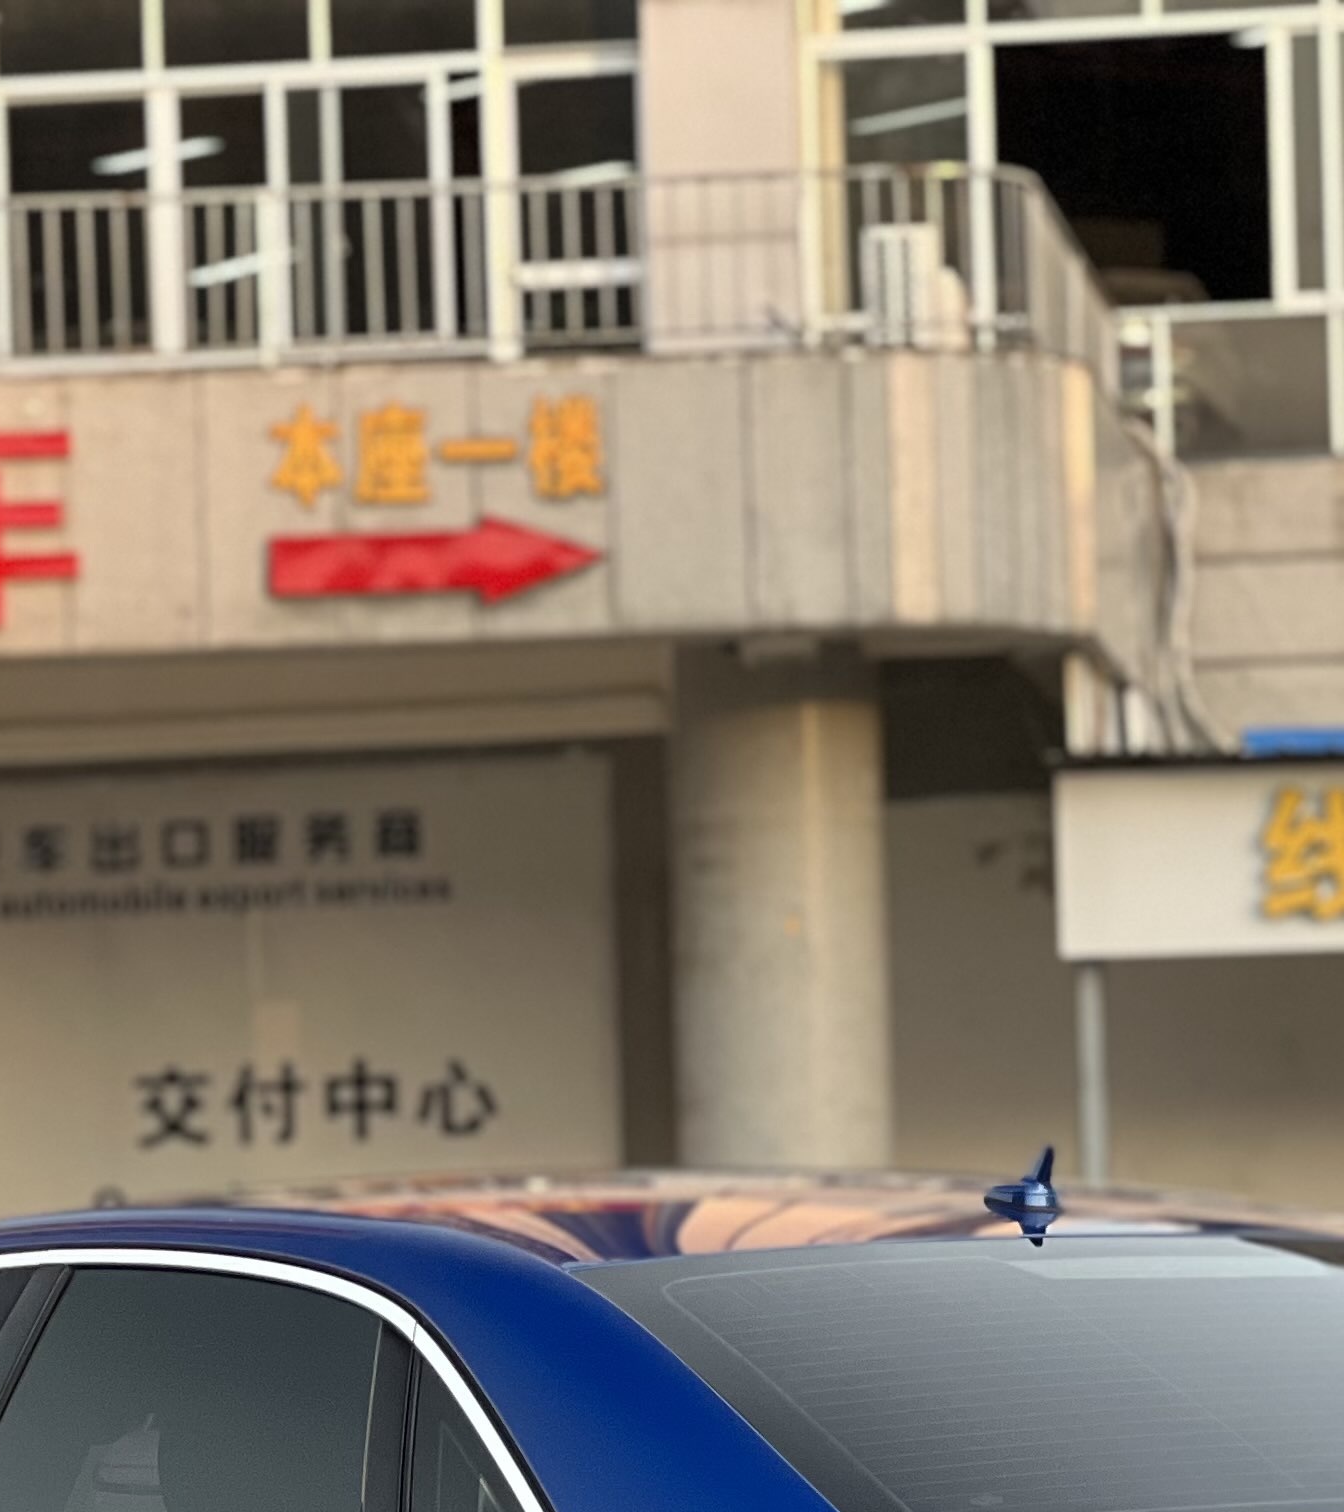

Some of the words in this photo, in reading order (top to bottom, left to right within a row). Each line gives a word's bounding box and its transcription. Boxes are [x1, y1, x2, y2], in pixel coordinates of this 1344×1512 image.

[0, 880, 186, 920] automobile
[134, 1057, 499, 1150] 交付中心
